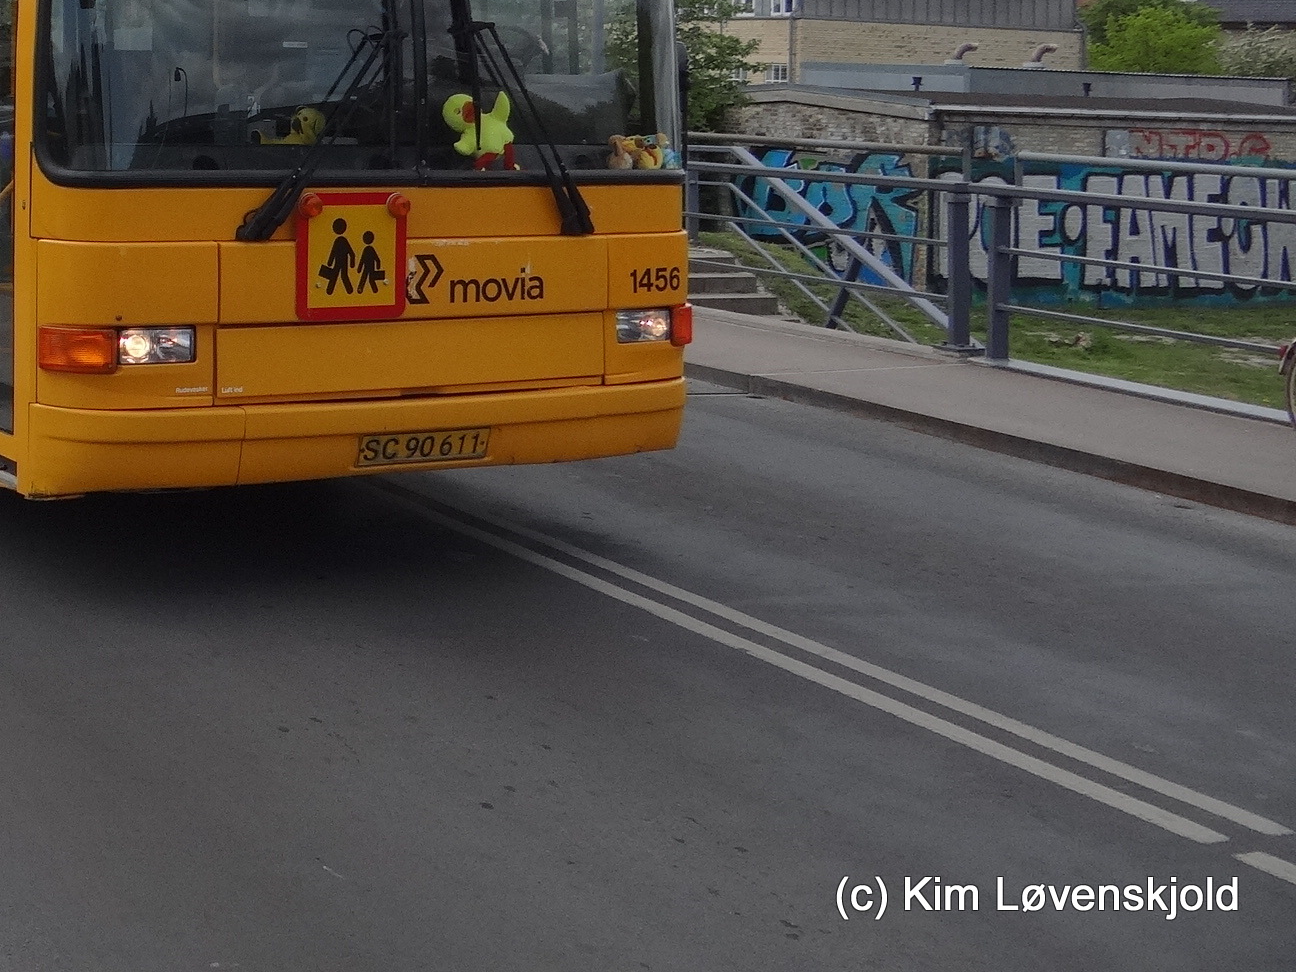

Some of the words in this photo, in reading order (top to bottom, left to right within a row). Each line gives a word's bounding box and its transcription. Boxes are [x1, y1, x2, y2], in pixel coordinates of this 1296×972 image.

[449, 264, 545, 304] movia
[630, 266, 682, 294] 1456
[362, 436, 400, 461] SC
[405, 434, 436, 458] 90
[439, 432, 482, 456] 611
